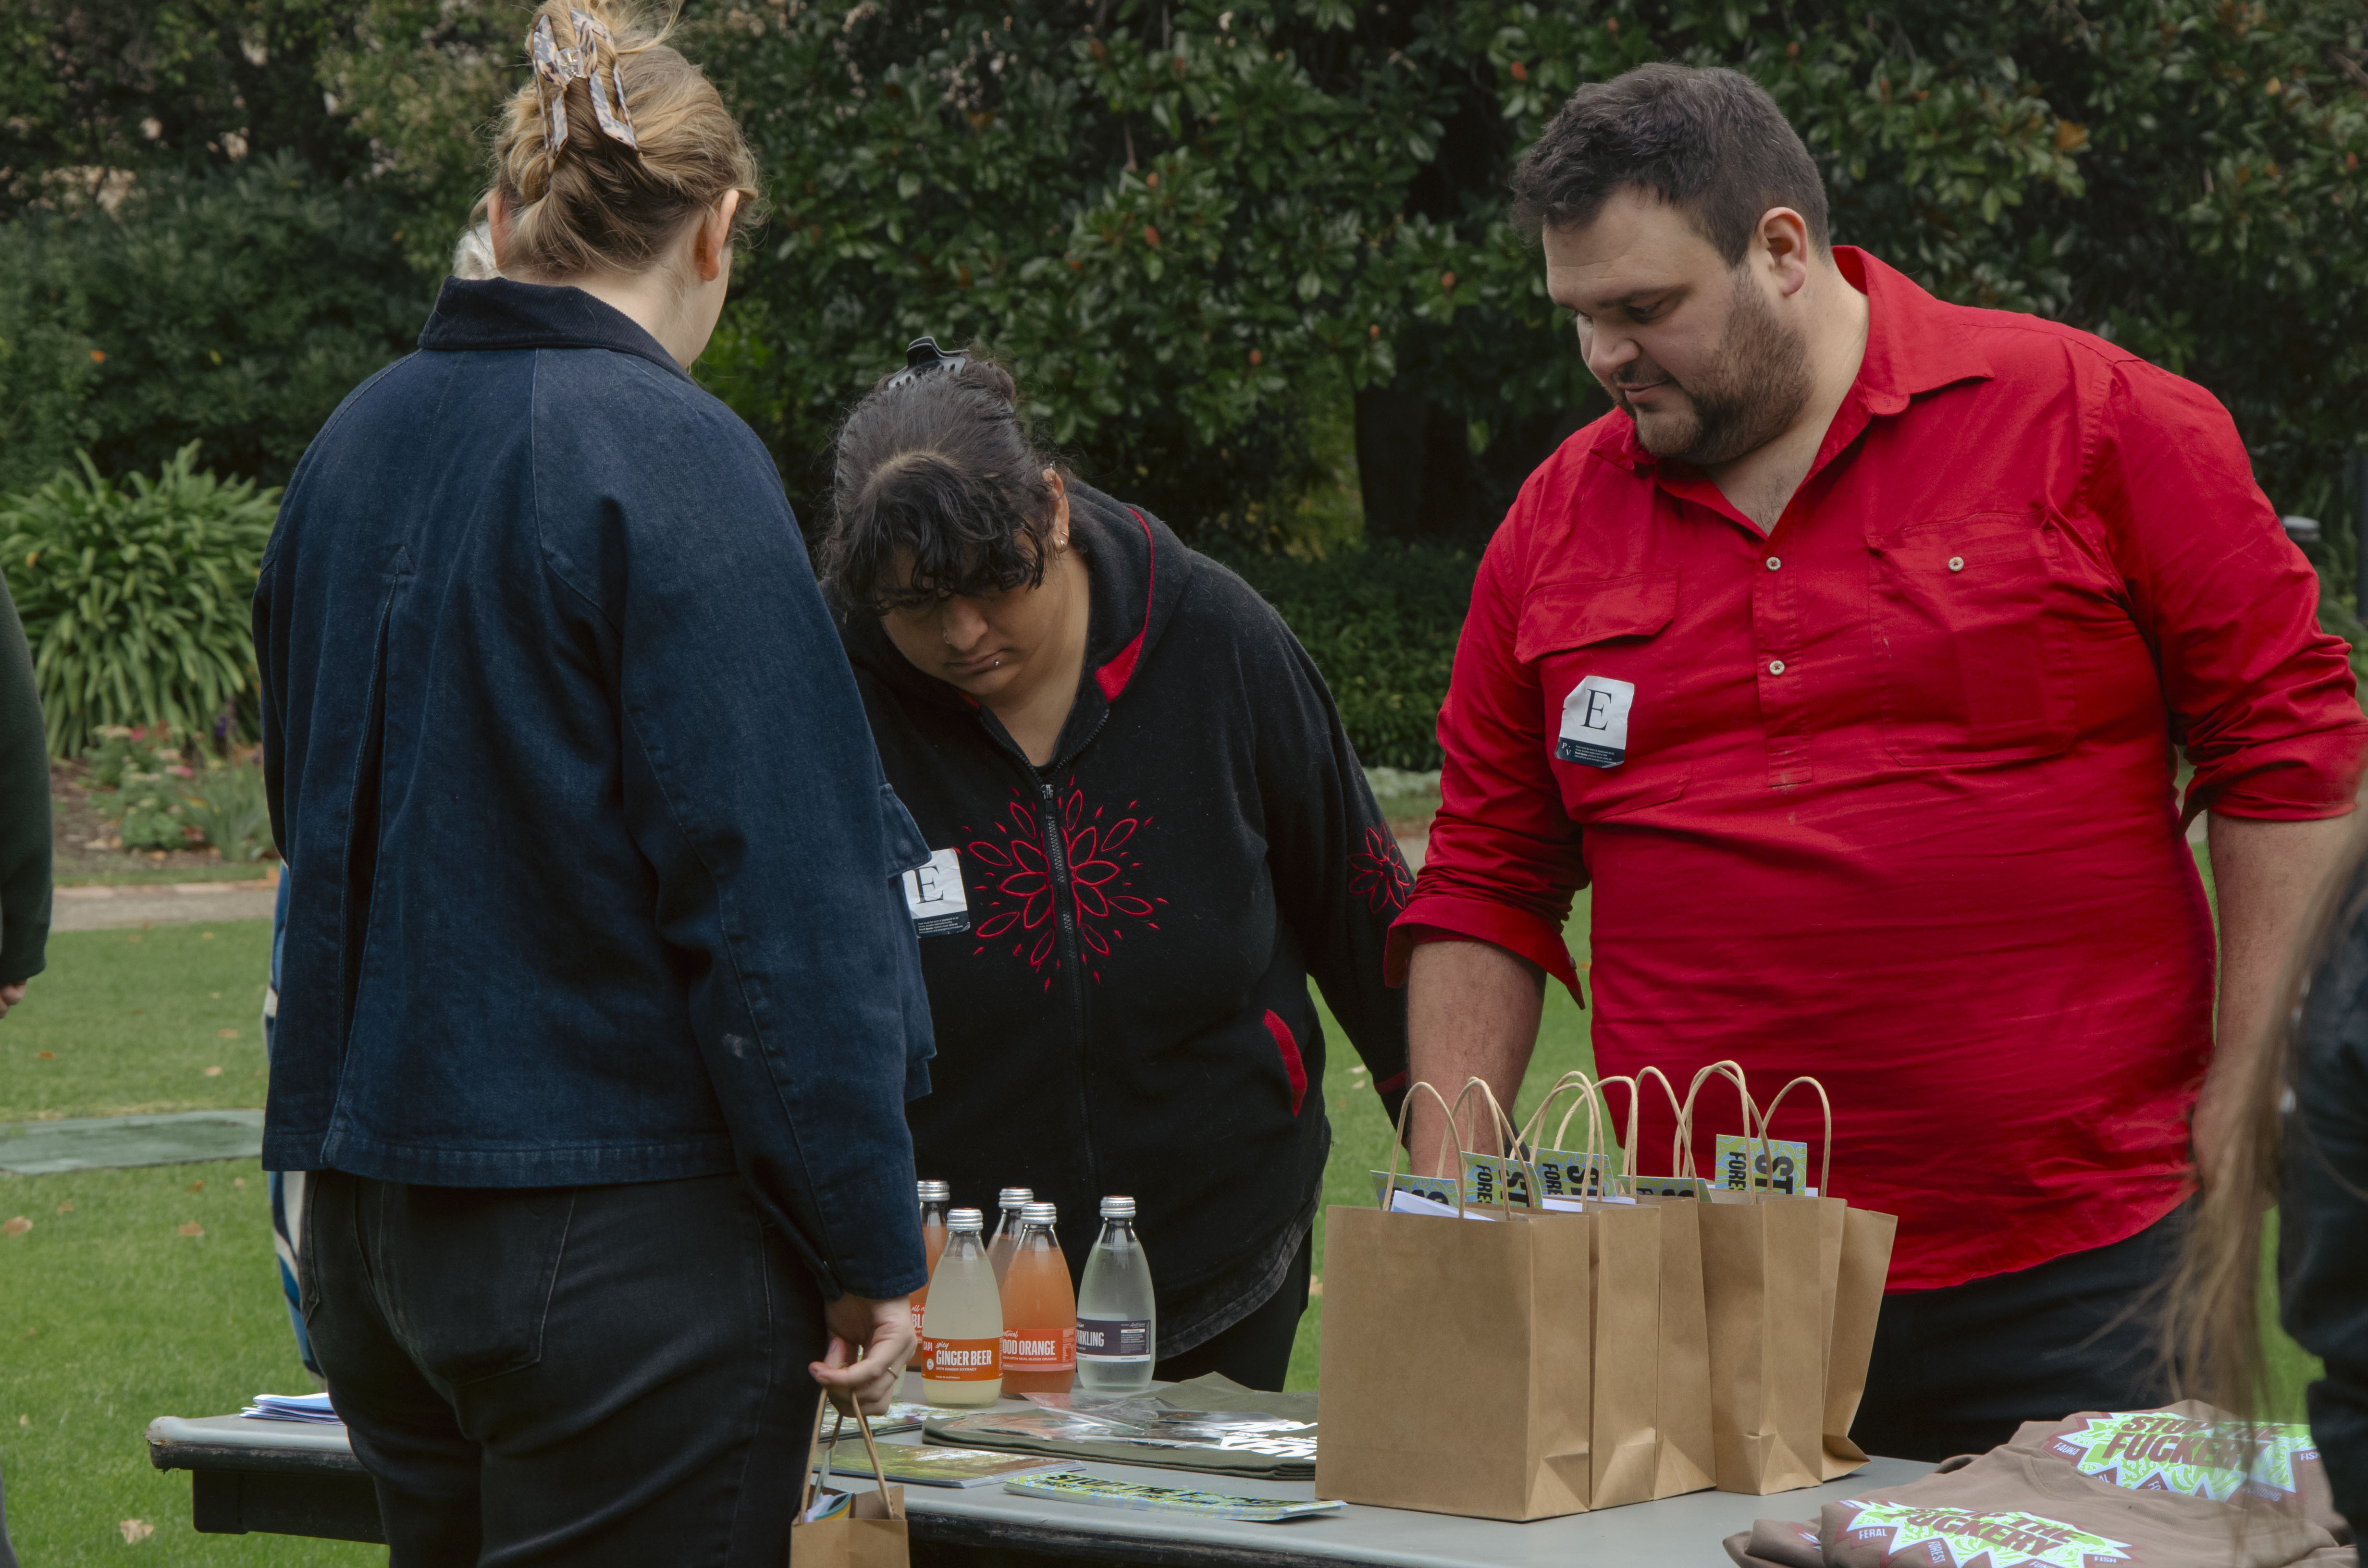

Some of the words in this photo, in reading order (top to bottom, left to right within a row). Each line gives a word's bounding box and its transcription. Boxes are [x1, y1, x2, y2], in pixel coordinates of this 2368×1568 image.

[1580, 688, 1612, 731] E
[910, 865, 944, 905] E
[1728, 1152, 1747, 1191] FORE
[1476, 1164, 1493, 1204] FORE
[935, 1341, 950, 1350] spicy
[1019, 1340, 1056, 1356] ORANGE
[936, 1350, 969, 1366] GINGER
[971, 1349, 992, 1366] BEER
[2121, 1416, 2215, 1435] STOP
[2053, 1442, 2081, 1456] FAUNA
[2102, 1432, 2269, 1472] FUCKERY
[1859, 1528, 1887, 1540] FERAL
[2009, 1518, 2086, 1544] THE
[1928, 1541, 1946, 1564] FOREST
